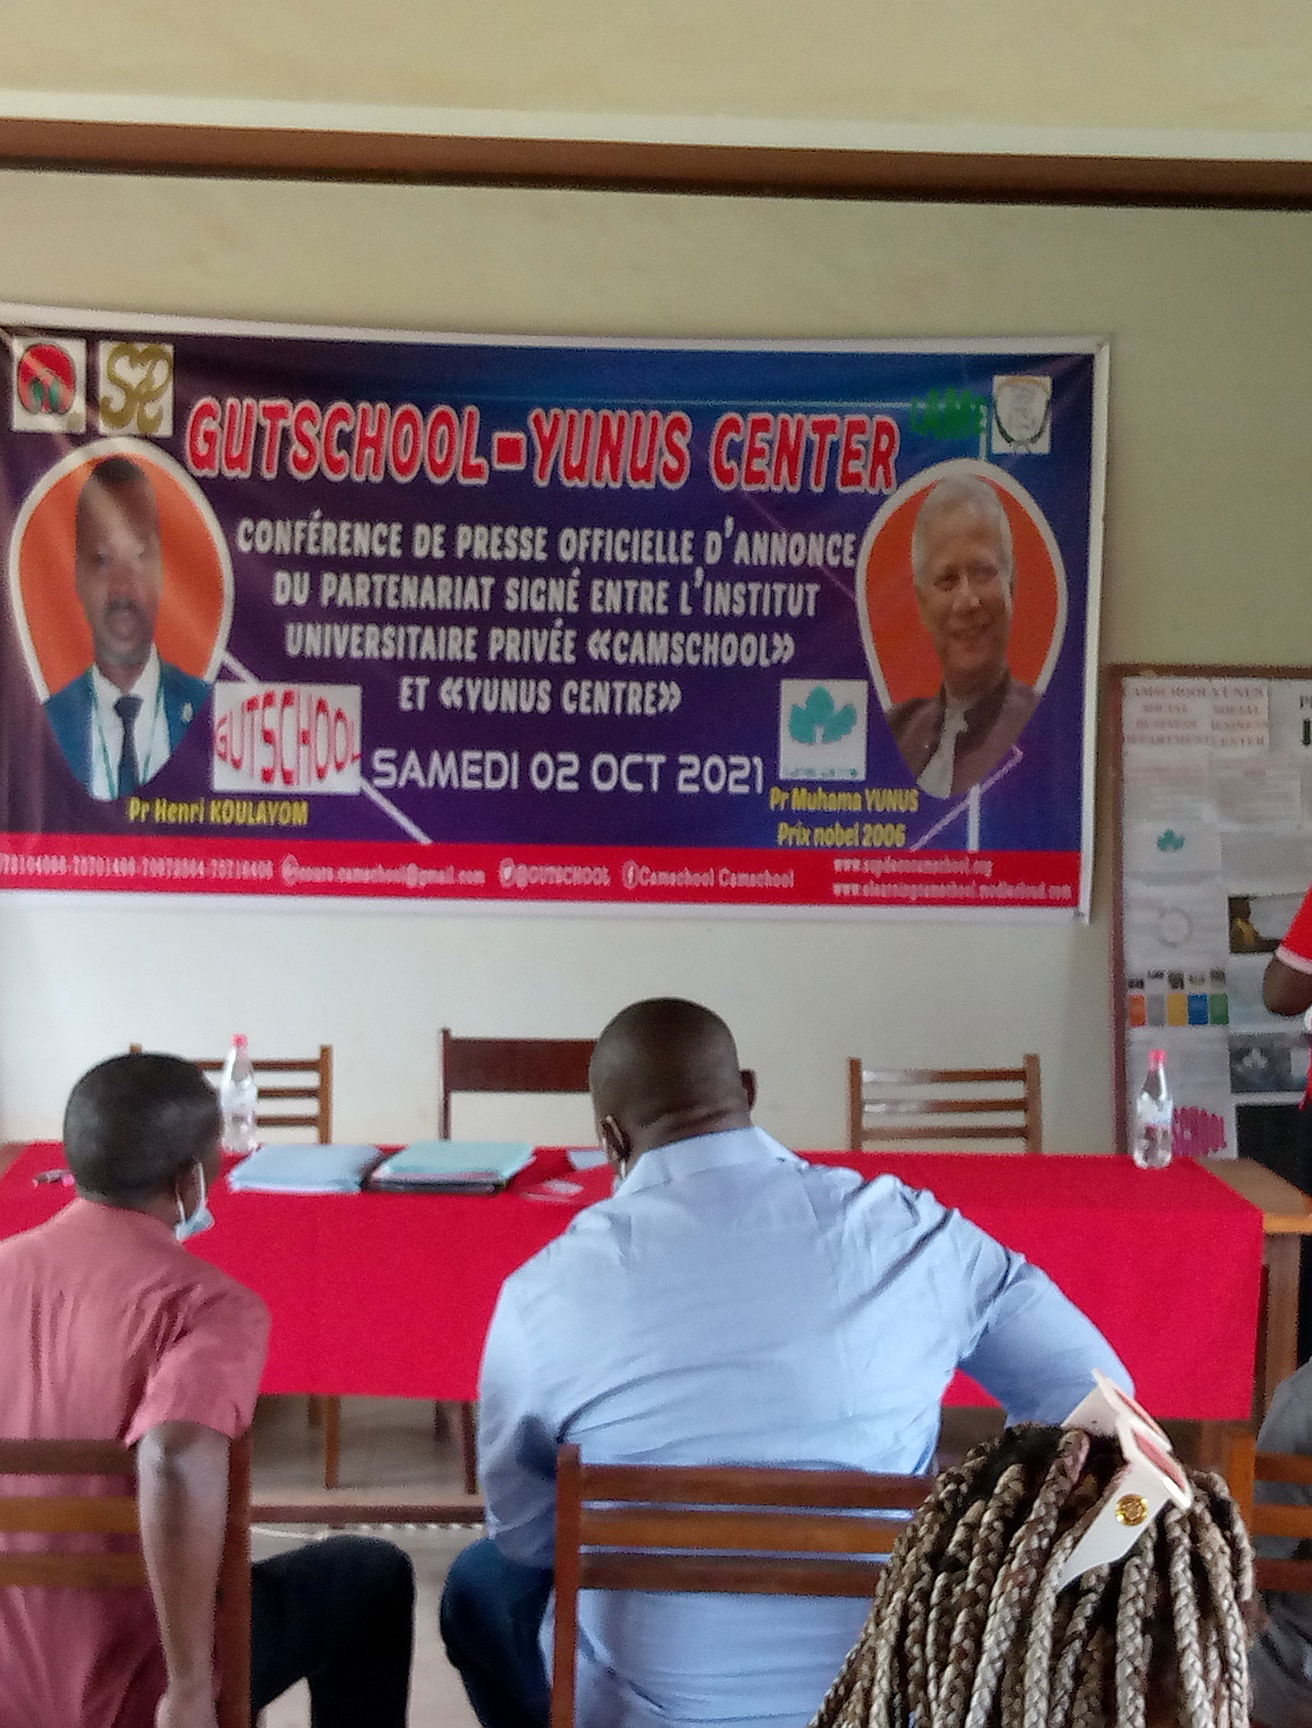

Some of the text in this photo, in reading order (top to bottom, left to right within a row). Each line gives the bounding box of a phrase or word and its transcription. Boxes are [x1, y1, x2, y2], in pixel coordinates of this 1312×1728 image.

[710, 412, 899, 494] CENTER
[236, 509, 857, 568] CONFÉRENCE DE PRESSE OFFICIELLE D'ANNONCE
[273, 567, 821, 618] DU PARTENARIAT SIGNÉ ENTRE L'INSTITUT
[285, 622, 480, 663] UNIVERSITAIRE
[489, 618, 576, 663] PRIVÉE
[399, 676, 429, 712] ET
[214, 688, 362, 788] GUTSCHOOL
[373, 748, 765, 795] SAMEDI 02 OCT 2021
[127, 798, 151, 823] Pr
[154, 799, 206, 823] Henri
[769, 788, 788, 812] Pr
[865, 790, 920, 814] YUNUS
[777, 823, 907, 849] Prix nobel 2006
